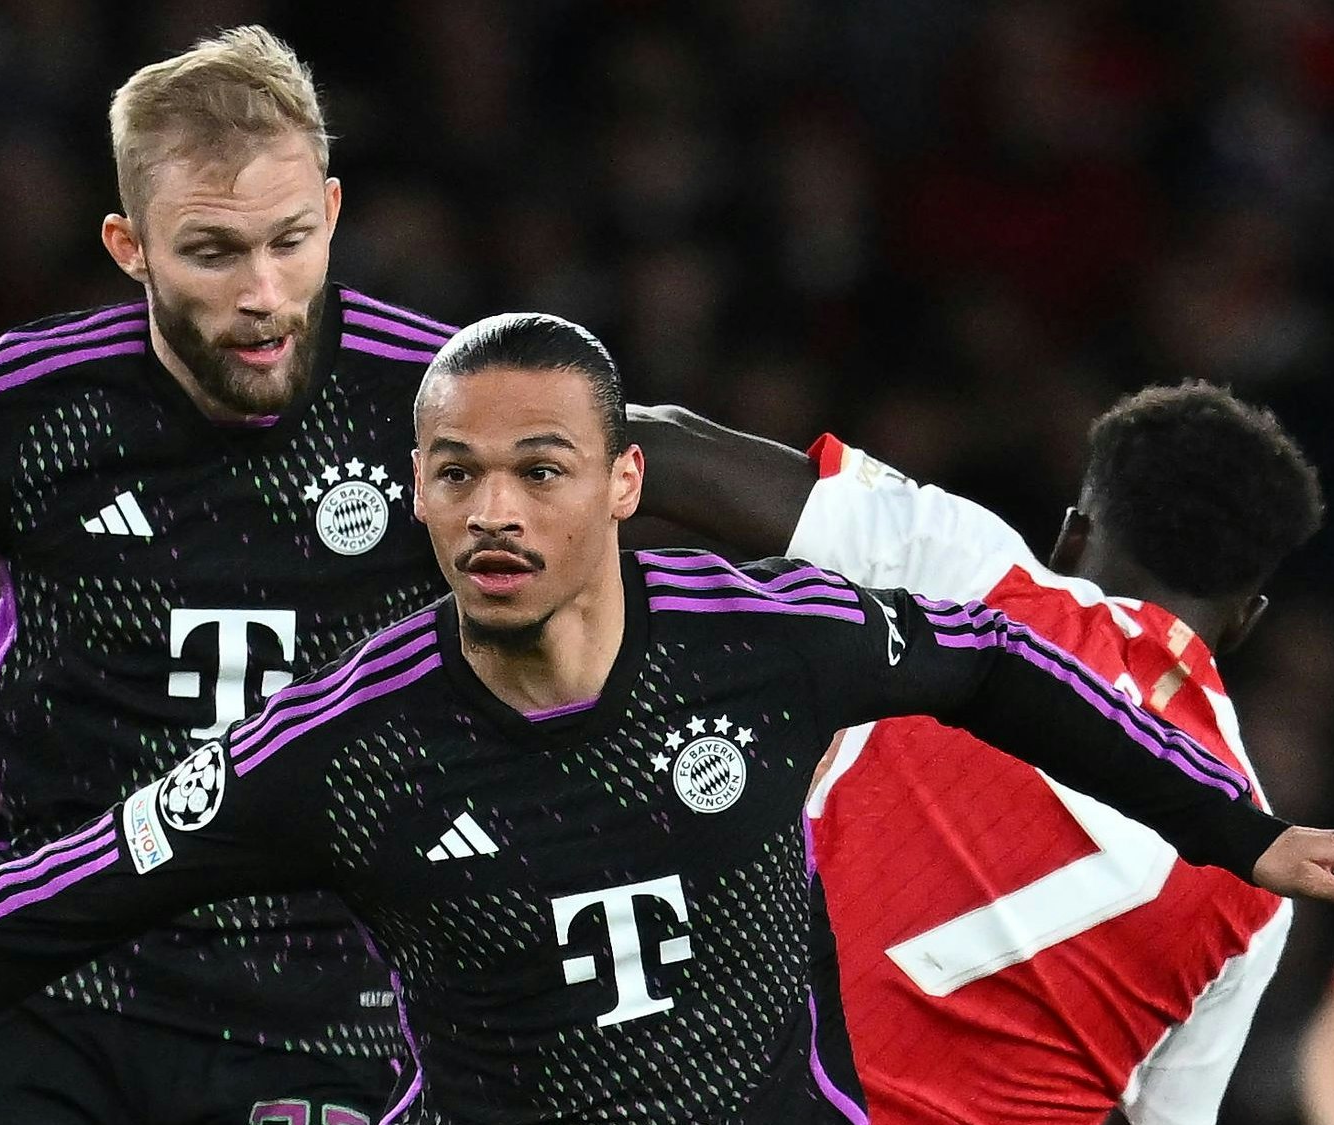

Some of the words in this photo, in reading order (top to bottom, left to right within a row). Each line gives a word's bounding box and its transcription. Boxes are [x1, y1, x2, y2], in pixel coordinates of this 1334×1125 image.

[340, 488, 382, 513] BAYERN
[168, 608, 297, 740] T
[680, 760, 691, 777] FC
[689, 743, 736, 763] BAYERN
[550, 873, 693, 1028] T
